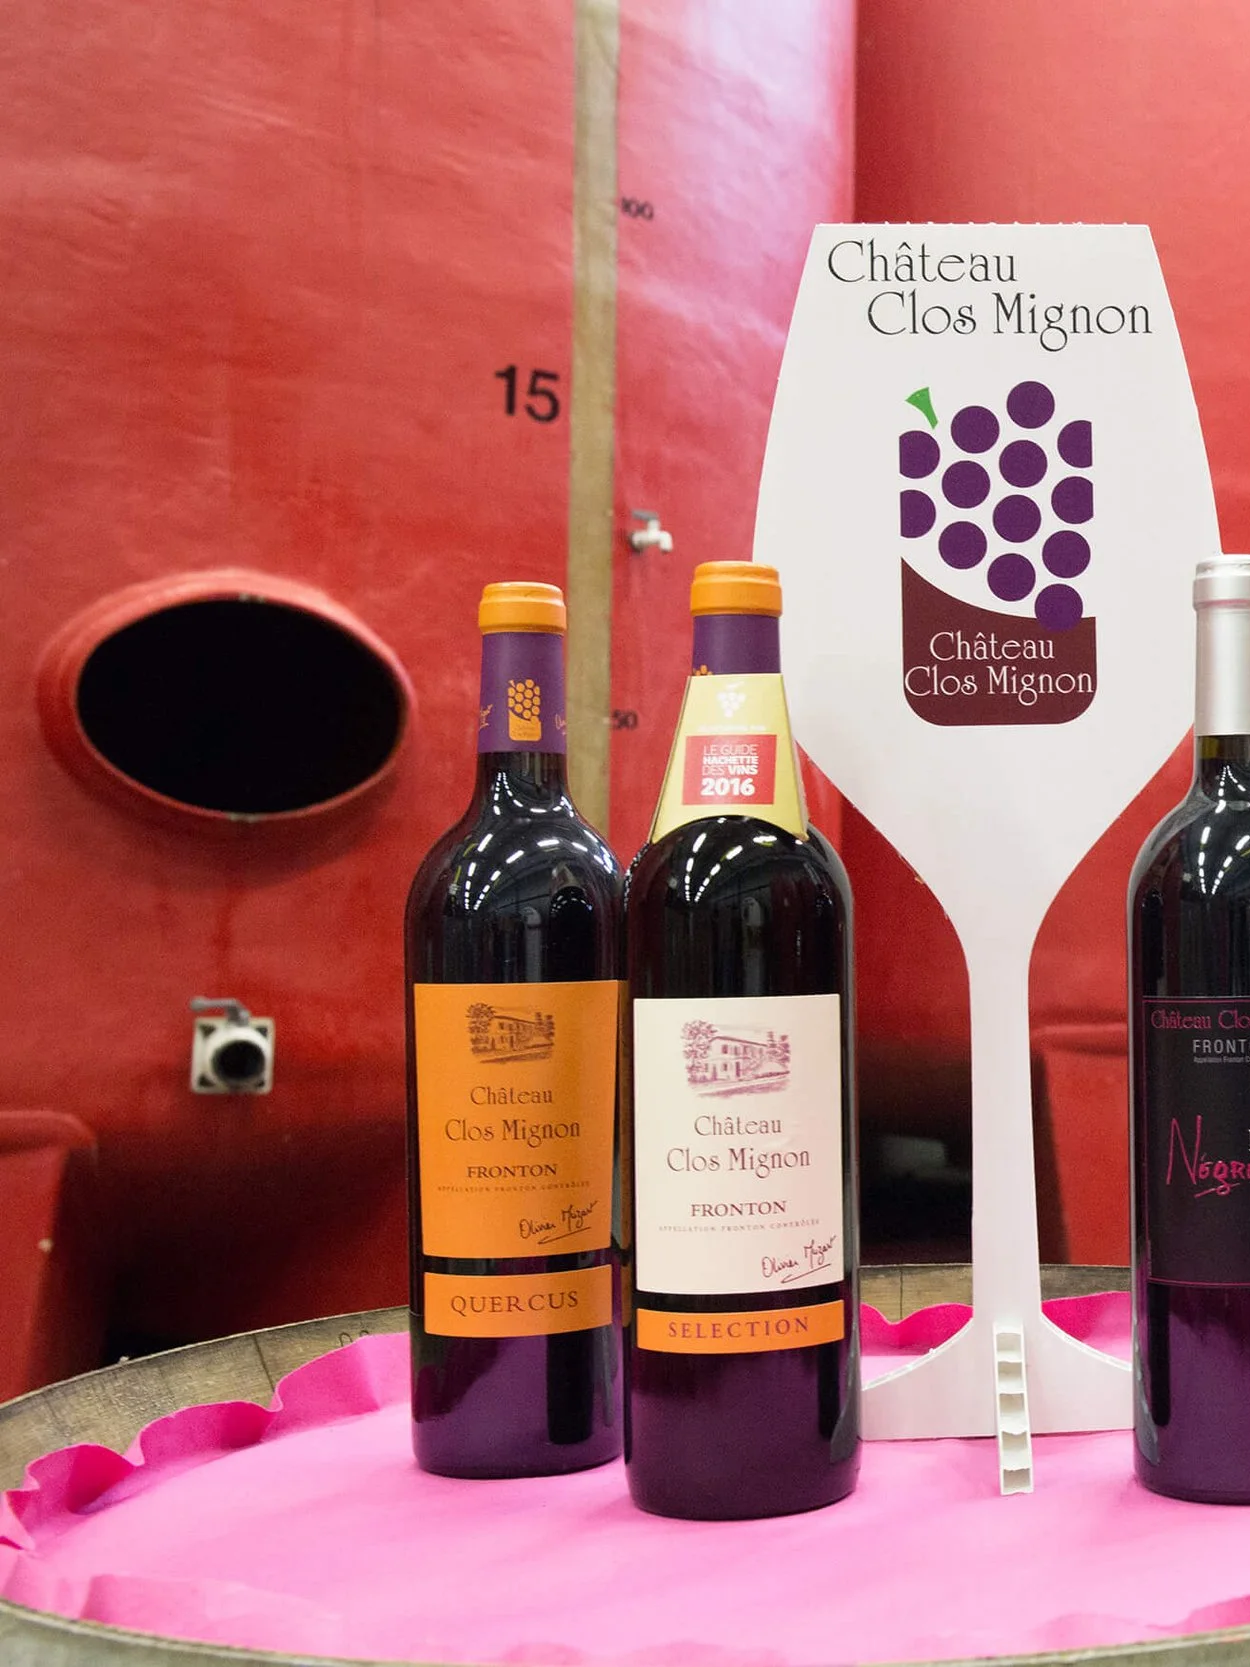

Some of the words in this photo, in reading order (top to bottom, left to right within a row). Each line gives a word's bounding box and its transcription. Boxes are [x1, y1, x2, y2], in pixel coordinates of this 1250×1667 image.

[827, 238, 1017, 283] Château
[867, 288, 977, 337] Clos
[991, 292, 1153, 353] Mignon
[494, 364, 561, 423] 15
[929, 631, 1055, 661] Château
[904, 664, 977, 698] Clos
[987, 665, 1095, 706] Mignon
[702, 755, 759, 765] HACHETTE
[703, 744, 719, 755] LE
[720, 744, 759, 755] GUIDE
[702, 765, 725, 776] DES
[727, 764, 758, 775] VINS
[700, 777, 756, 796] 2016
[1150, 1007, 1212, 1029] Château
[470, 1086, 553, 1105] Château
[445, 1118, 495, 1142] Clos
[502, 1118, 581, 1148] Mignon
[694, 1115, 782, 1136] Château
[467, 1163, 558, 1179] FRONTON
[667, 1147, 722, 1172] Clos
[728, 1147, 811, 1179] Mignon
[691, 1200, 787, 1217] FRONTON
[721, 1224, 765, 1232] FRONTON
[451, 1291, 579, 1316] QUERCUS
[668, 1316, 809, 1339] SELECTION
